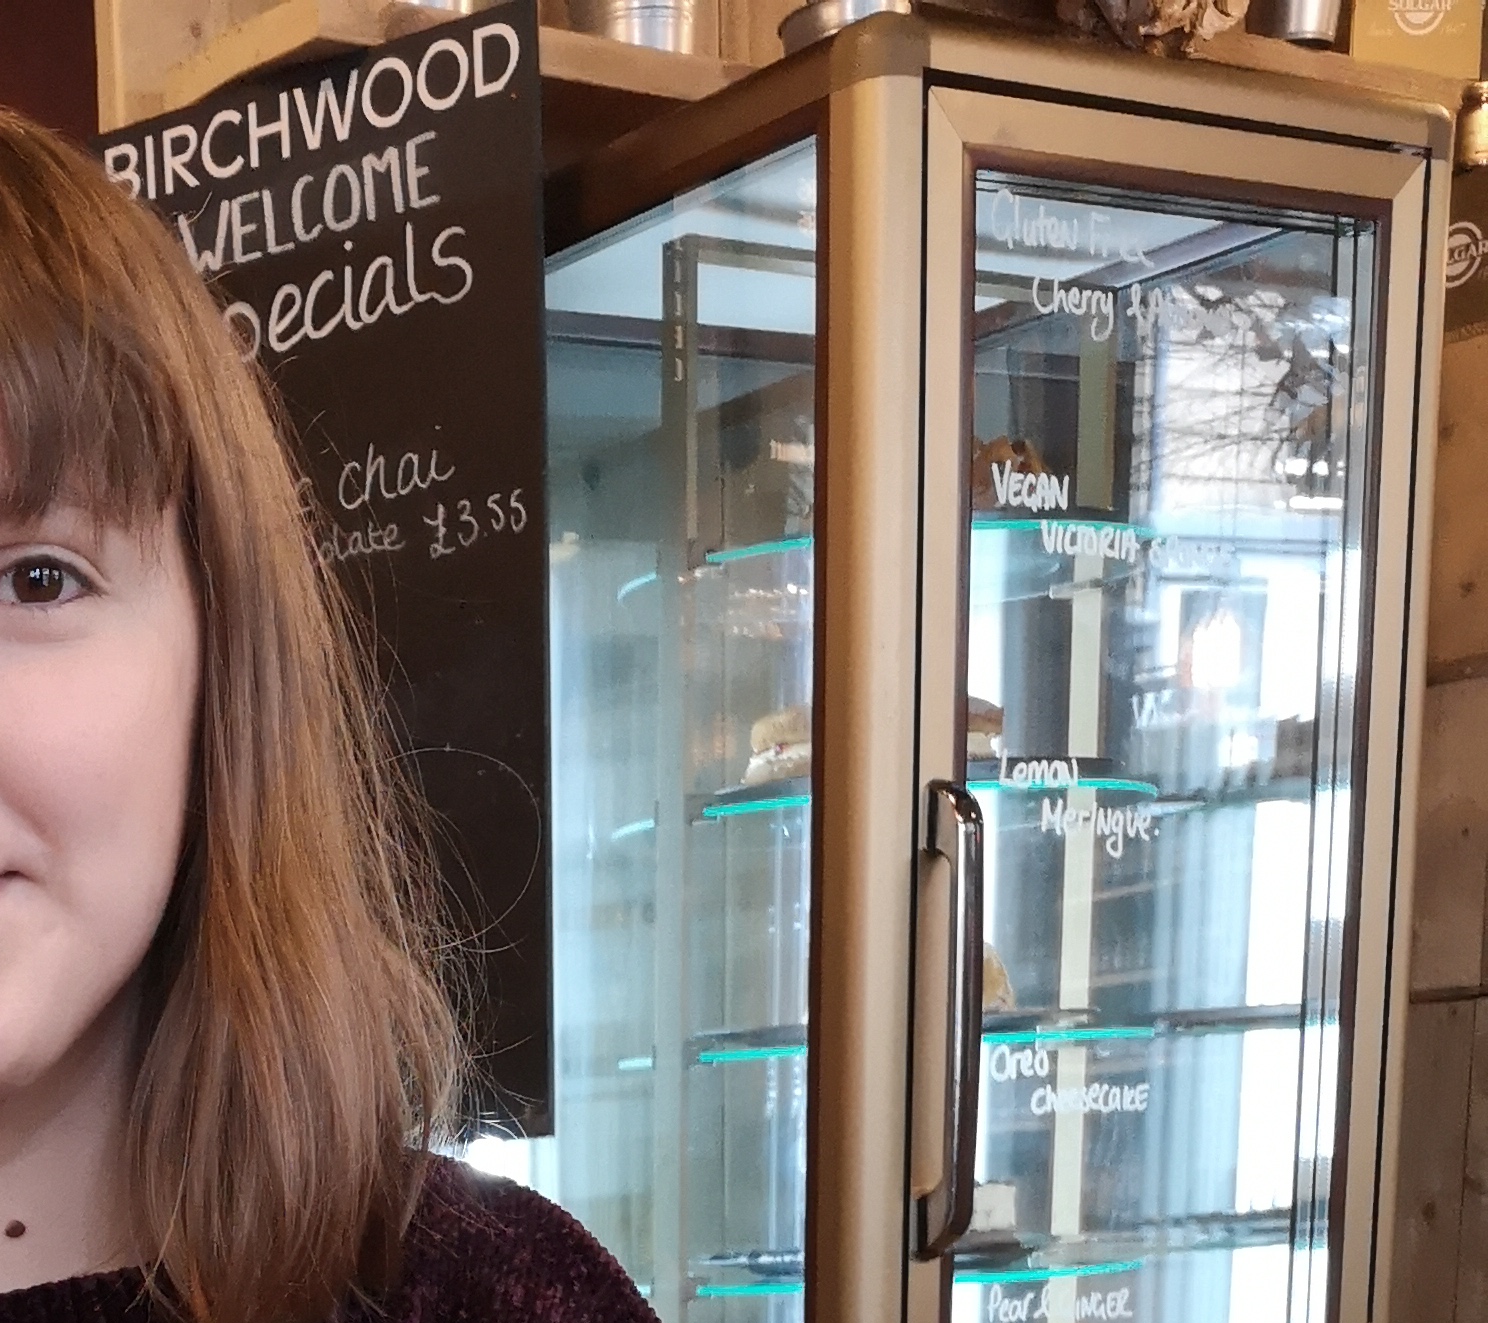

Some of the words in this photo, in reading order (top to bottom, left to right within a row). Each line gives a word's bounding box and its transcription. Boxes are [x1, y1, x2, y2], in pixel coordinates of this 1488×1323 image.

[104, 22, 519, 200] BIRCHWOOD
[178, 132, 441, 272] WELCOME
[223, 221, 473, 363] pecials
[1032, 276, 1114, 342] Cherry
[1041, 518, 1141, 563] VICTORIA
[990, 1044, 1050, 1082] Oreo
[987, 1283, 1035, 1323] Pear
